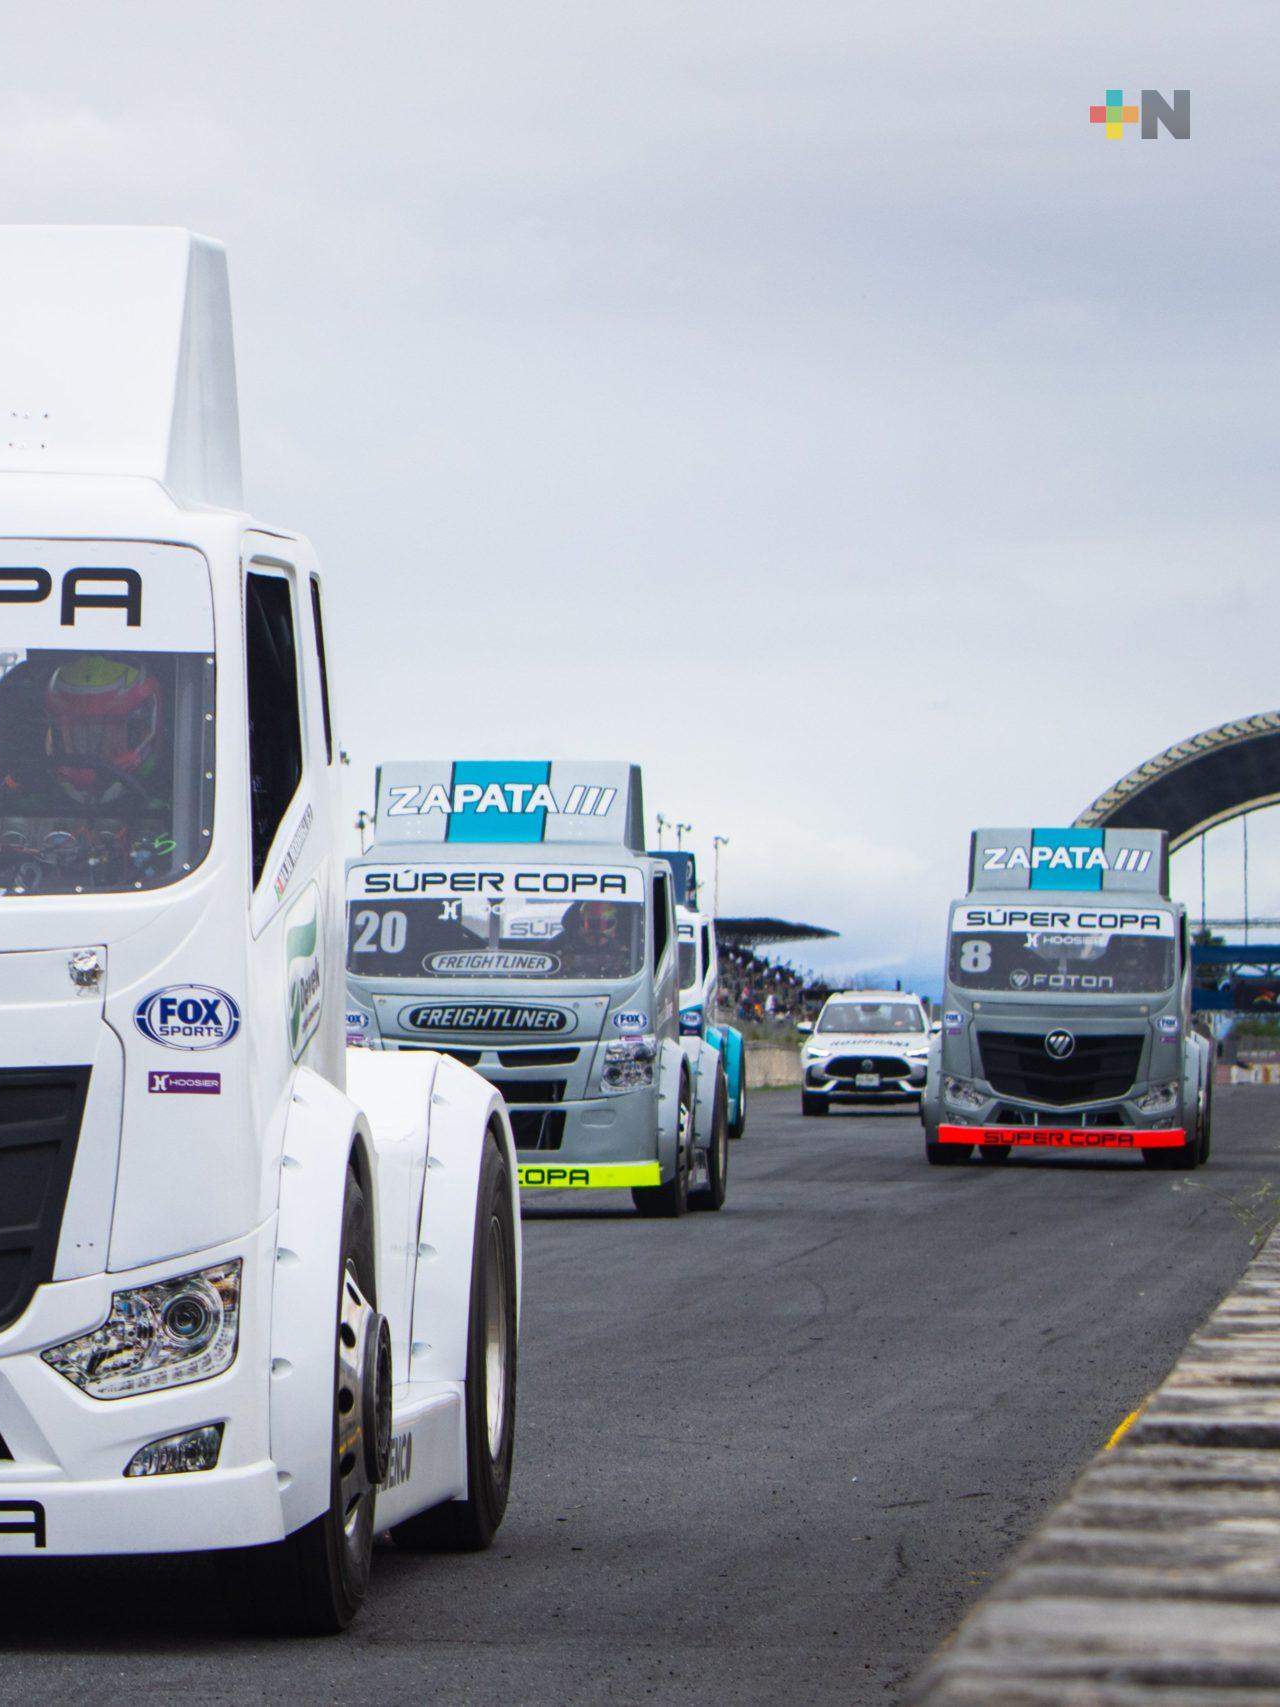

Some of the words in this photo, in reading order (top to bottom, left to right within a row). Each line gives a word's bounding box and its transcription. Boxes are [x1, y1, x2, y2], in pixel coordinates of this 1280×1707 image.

[388, 783, 560, 816] ZAPATA
[983, 847, 1109, 870] ZAPATA
[364, 869, 505, 893] SÚPER
[514, 872, 627, 893] COPA
[966, 909, 1071, 928] SÚPER
[1077, 913, 1160, 930] COPA
[353, 911, 408, 953] 20
[437, 955, 546, 970] FREIGHTLINER
[960, 941, 992, 974] 8
[1032, 974, 1113, 988] FOTON
[160, 998, 223, 1025] FOX
[416, 1009, 561, 1029] FREIGHTLINER
[620, 1014, 640, 1023] FOX
[159, 1026, 224, 1037] SPORTS
[169, 1079, 219, 1087] HOOSIER
[1069, 1132, 1134, 1146] COPA
[518, 1169, 589, 1185] OPA
